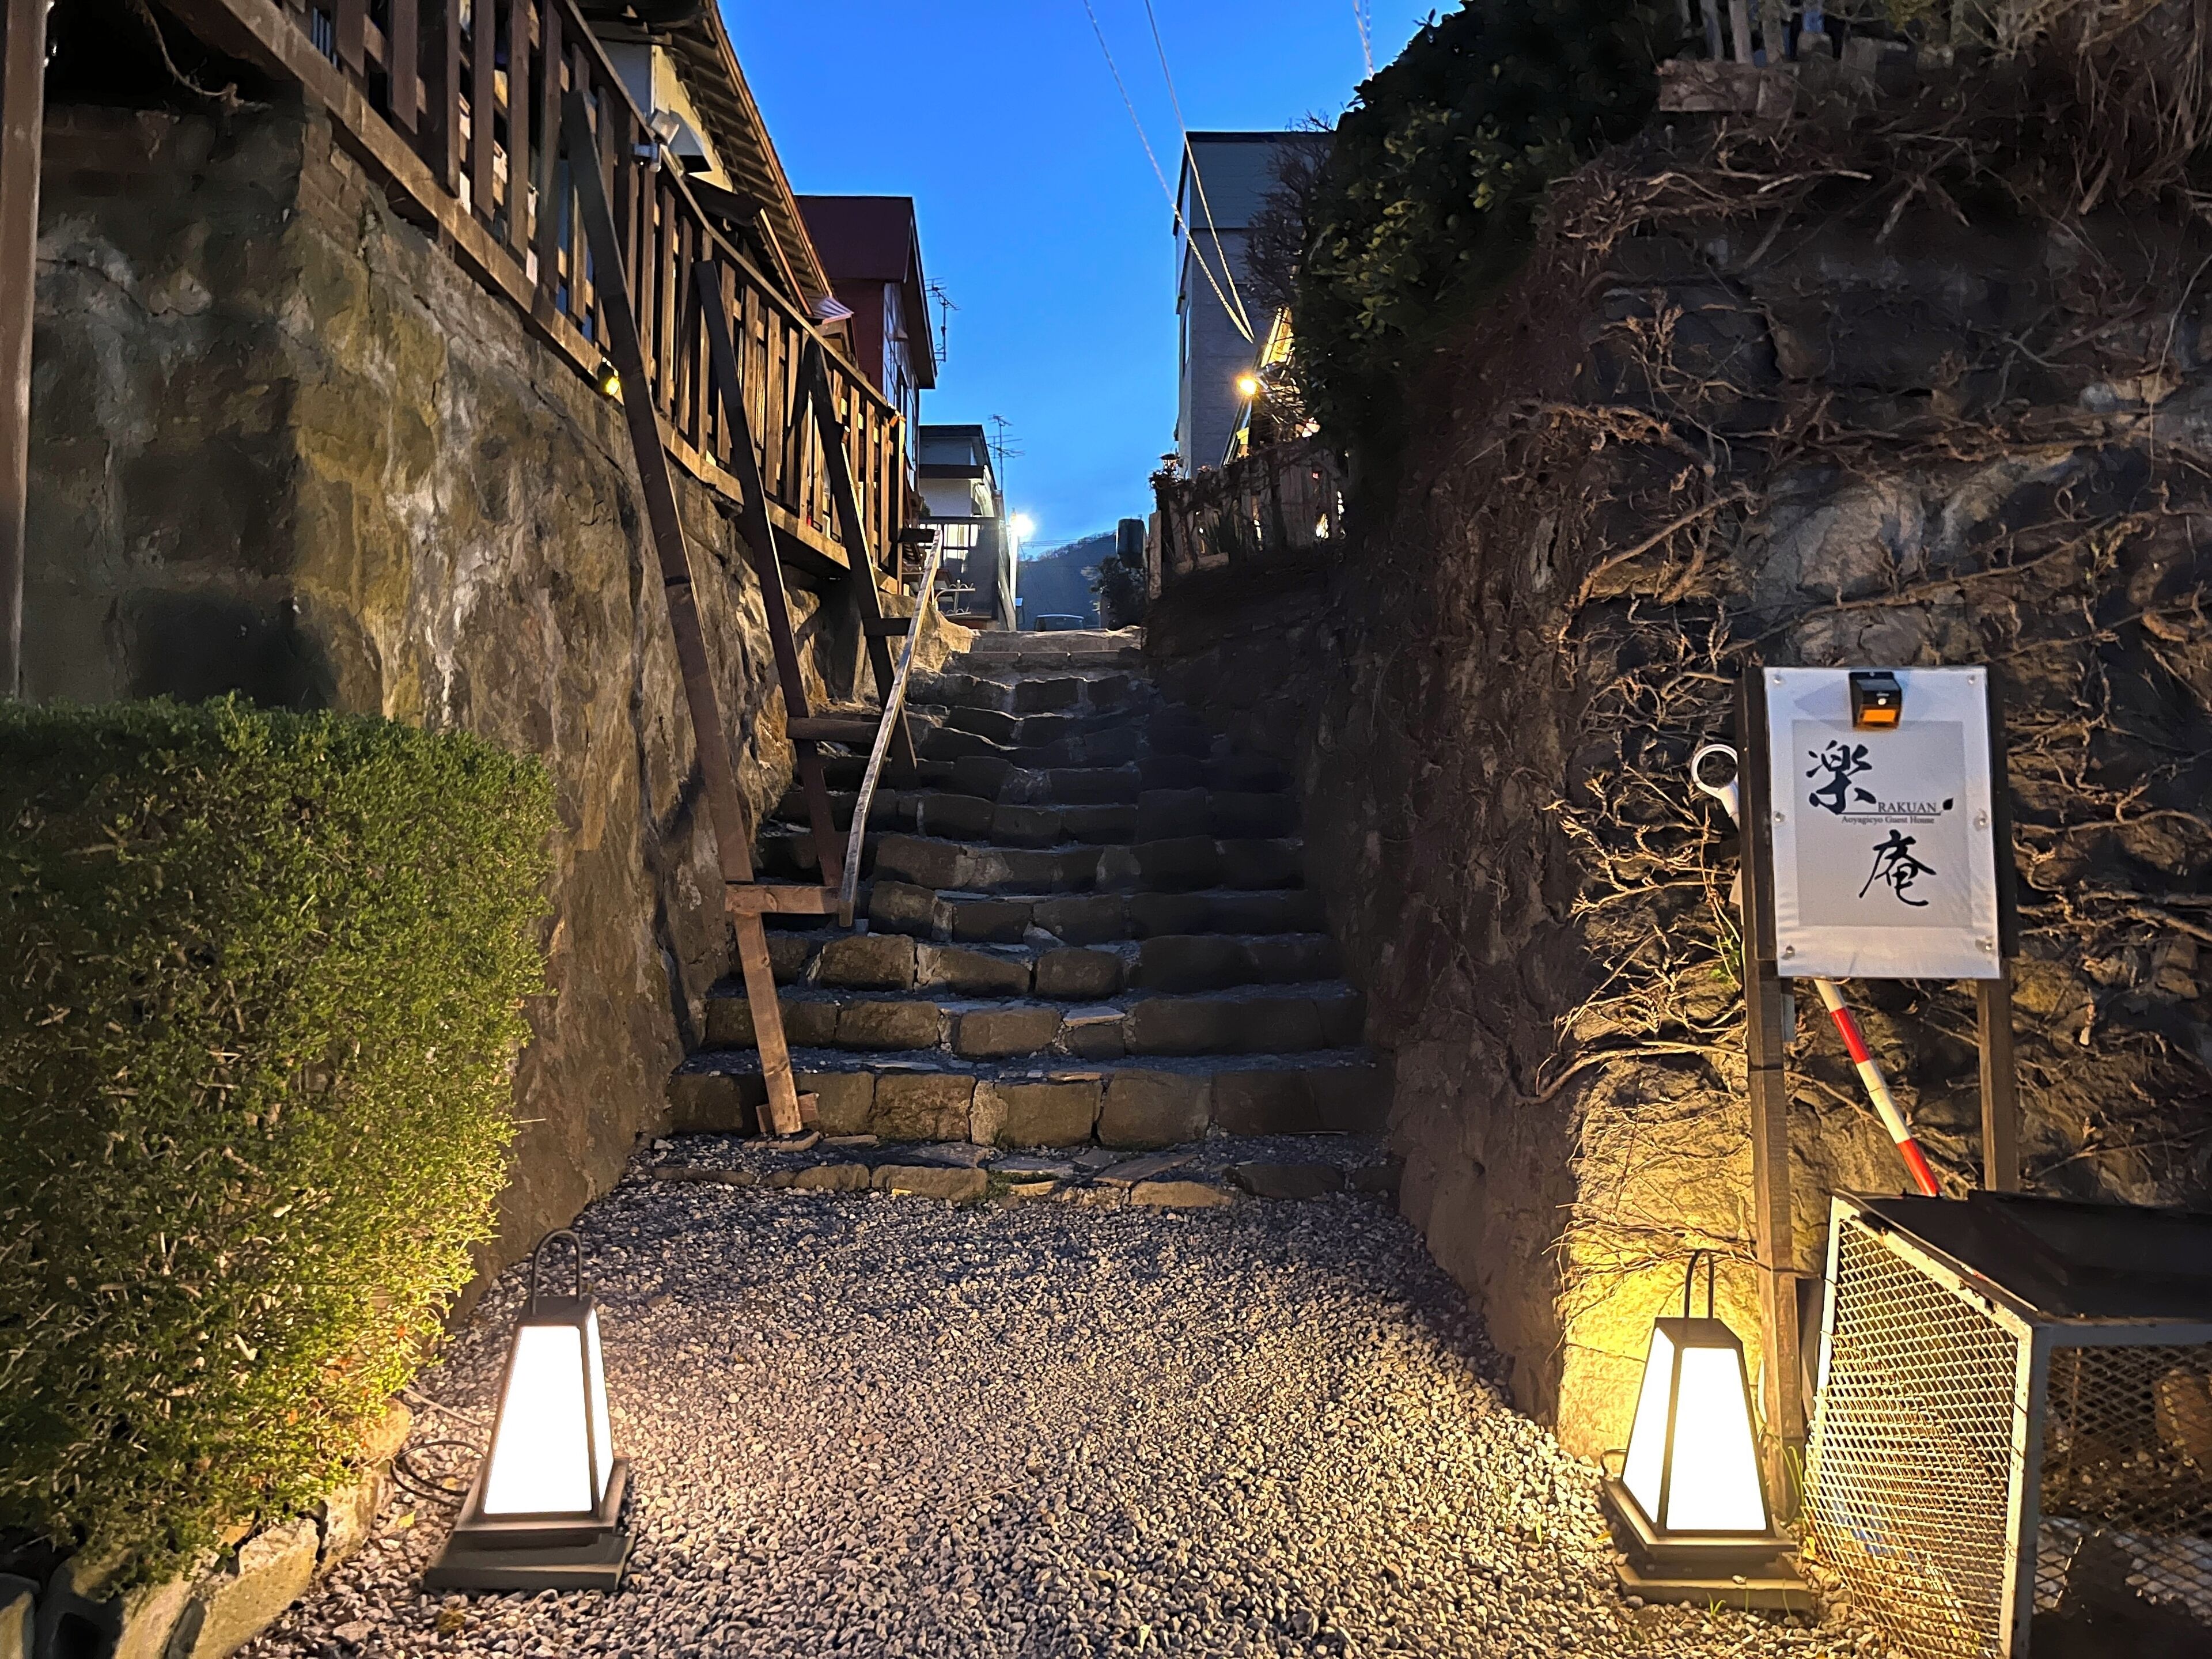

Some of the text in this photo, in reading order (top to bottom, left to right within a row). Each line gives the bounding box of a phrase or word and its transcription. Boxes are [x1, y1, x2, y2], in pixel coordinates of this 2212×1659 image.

[1878, 801, 1937, 813] RAKUAN
[1885, 816, 1908, 824] Guest
[1910, 816, 1934, 824] House
[1859, 829, 1936, 907] 庵
